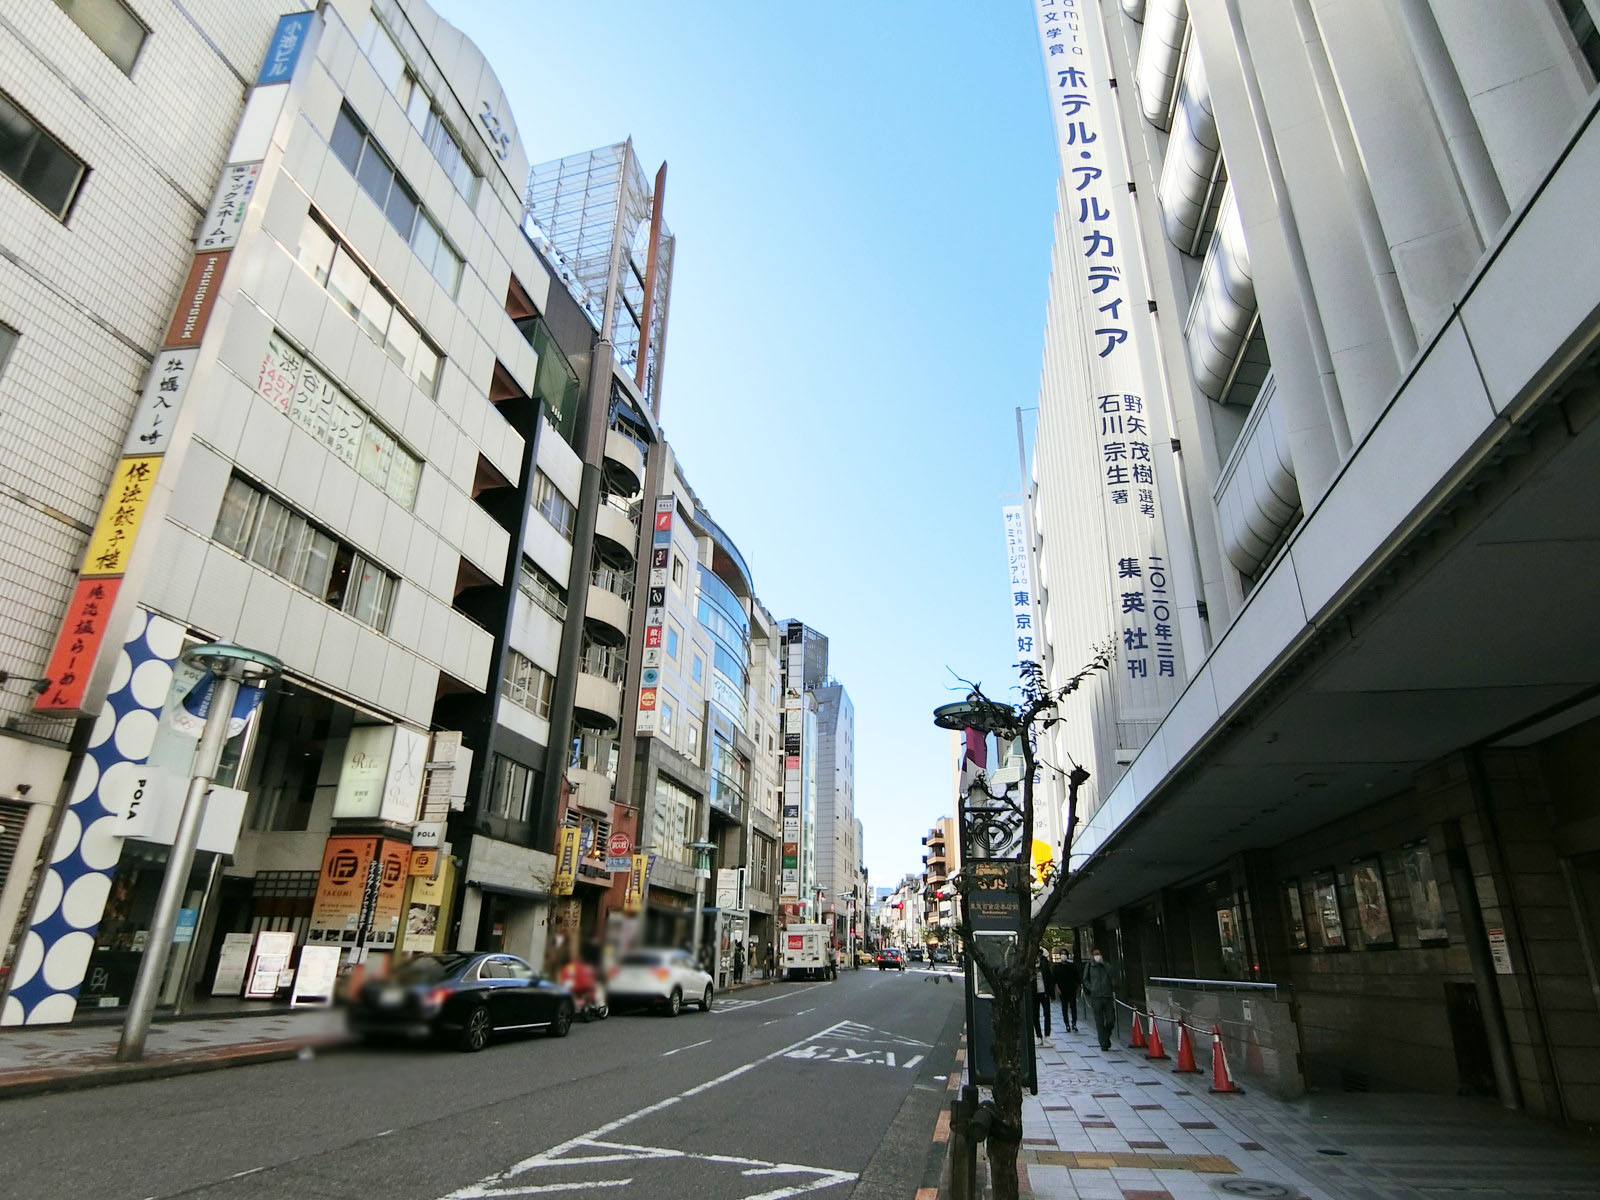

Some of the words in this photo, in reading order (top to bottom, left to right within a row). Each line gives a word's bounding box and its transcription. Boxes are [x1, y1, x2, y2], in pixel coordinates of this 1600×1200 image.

[1058, 66, 1128, 358] ホテル・アルカディア
[1118, 557, 1149, 679] 集英社刊
[183, 670, 199, 681] POL
[126, 778, 147, 822] POLA
[416, 830, 437, 839] POLA
